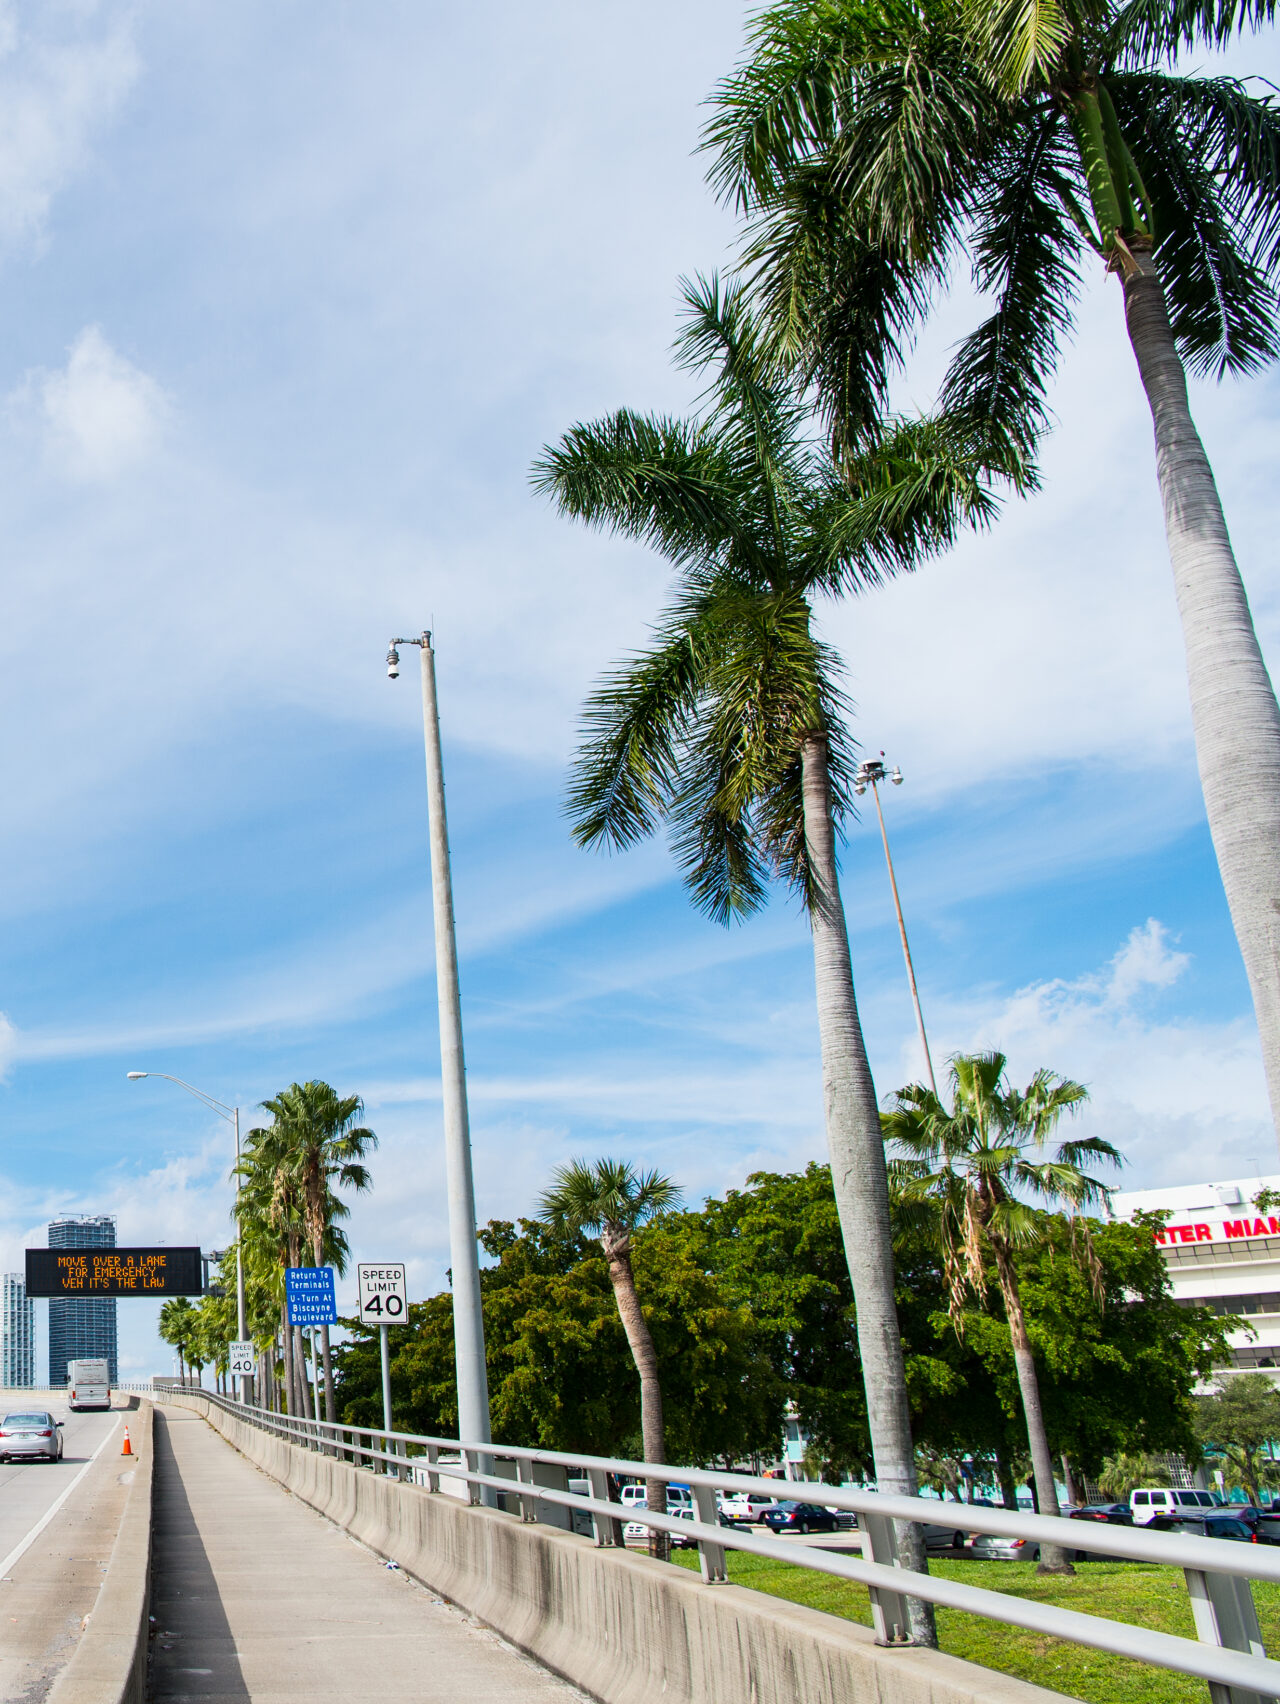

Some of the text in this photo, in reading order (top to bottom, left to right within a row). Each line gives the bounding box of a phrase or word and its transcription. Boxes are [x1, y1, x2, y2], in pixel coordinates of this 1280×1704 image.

[1149, 1224, 1213, 1245] NTER
[58, 1255, 167, 1267] MOVE OVER A LANE
[68, 1266, 156, 1278] FOR EMERGENCY
[291, 1271, 329, 1280] Return To
[362, 1270, 401, 1279] SPEED
[62, 1277, 165, 1288] VEH IT'S THE LAW
[291, 1280, 330, 1289] Terminals
[367, 1282, 397, 1291] LIMIT
[323, 1293, 332, 1302] At
[292, 1303, 331, 1313] Biscayne
[364, 1294, 403, 1316] 40
[291, 1313, 334, 1322] Boulevard
[232, 1360, 252, 1371] 40
